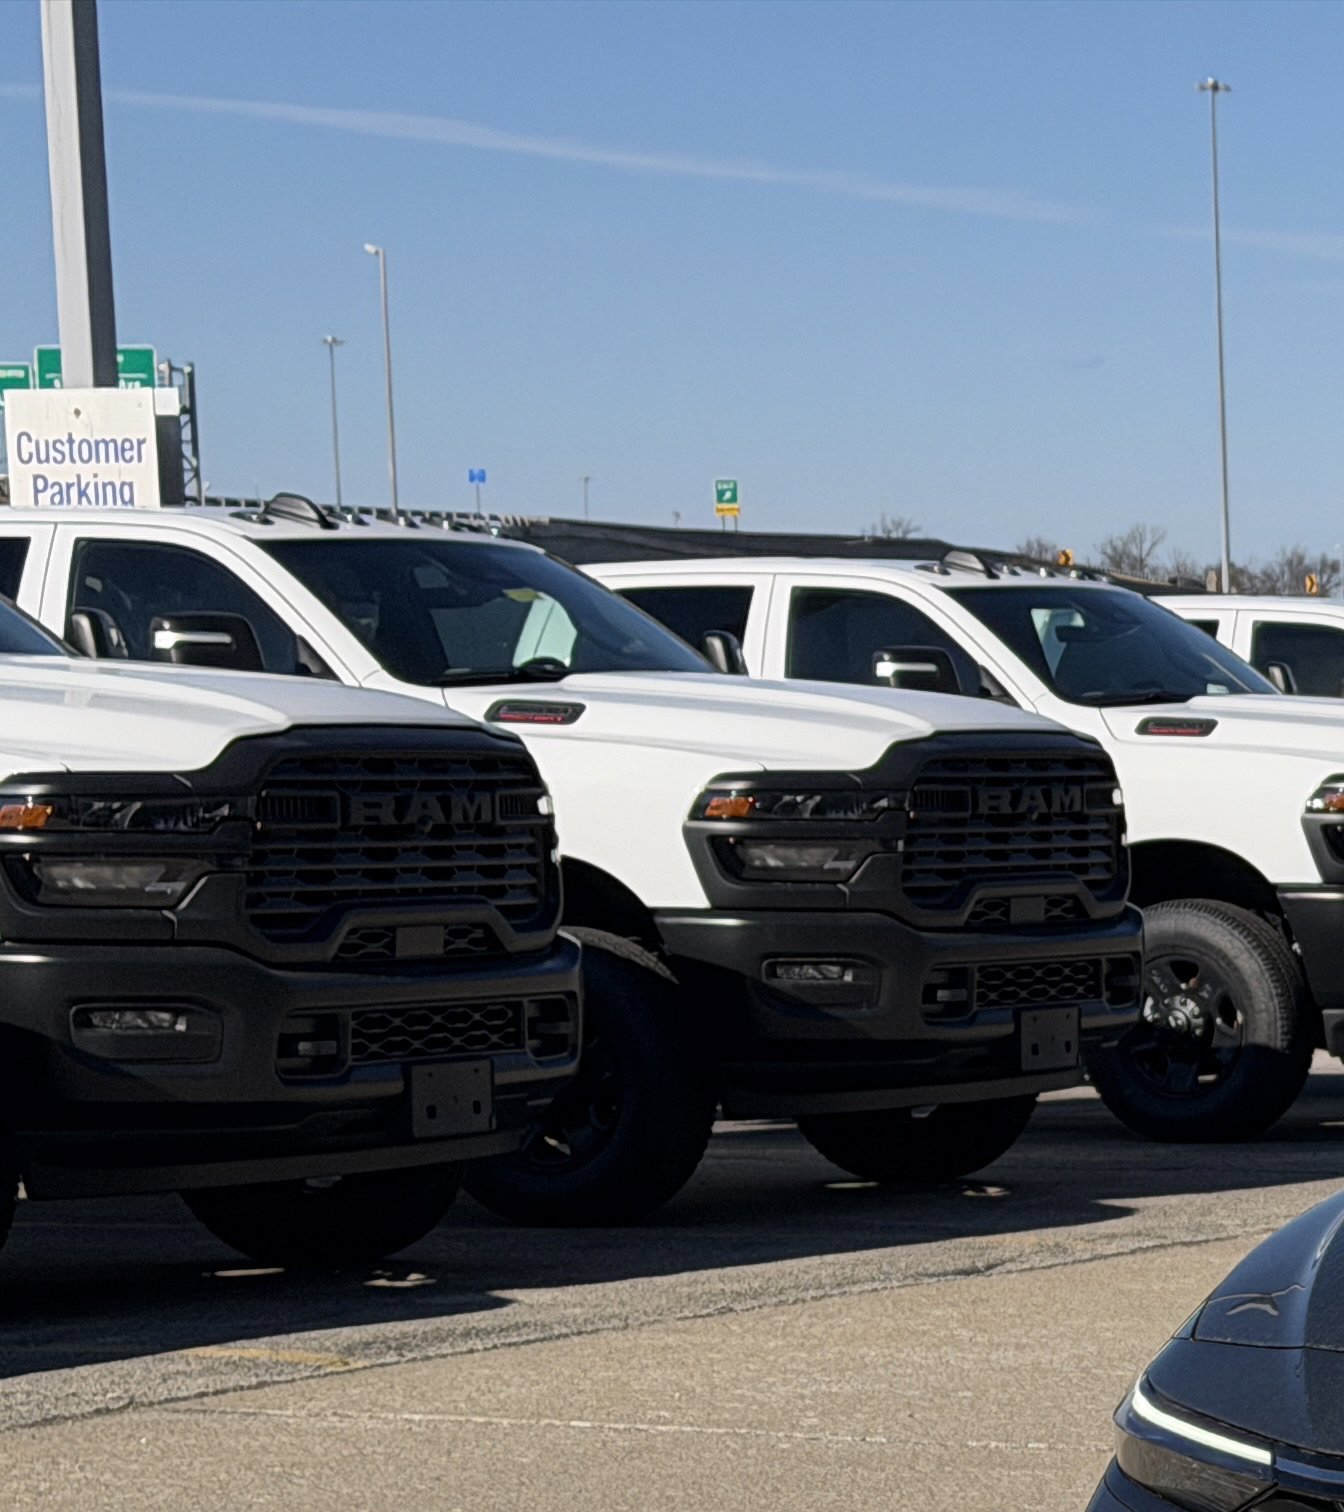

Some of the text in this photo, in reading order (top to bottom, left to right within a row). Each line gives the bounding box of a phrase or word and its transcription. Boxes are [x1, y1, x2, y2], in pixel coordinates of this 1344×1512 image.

[16, 431, 147, 465] Customer
[348, 791, 493, 825] RAM
[977, 784, 1082, 814] RAM
